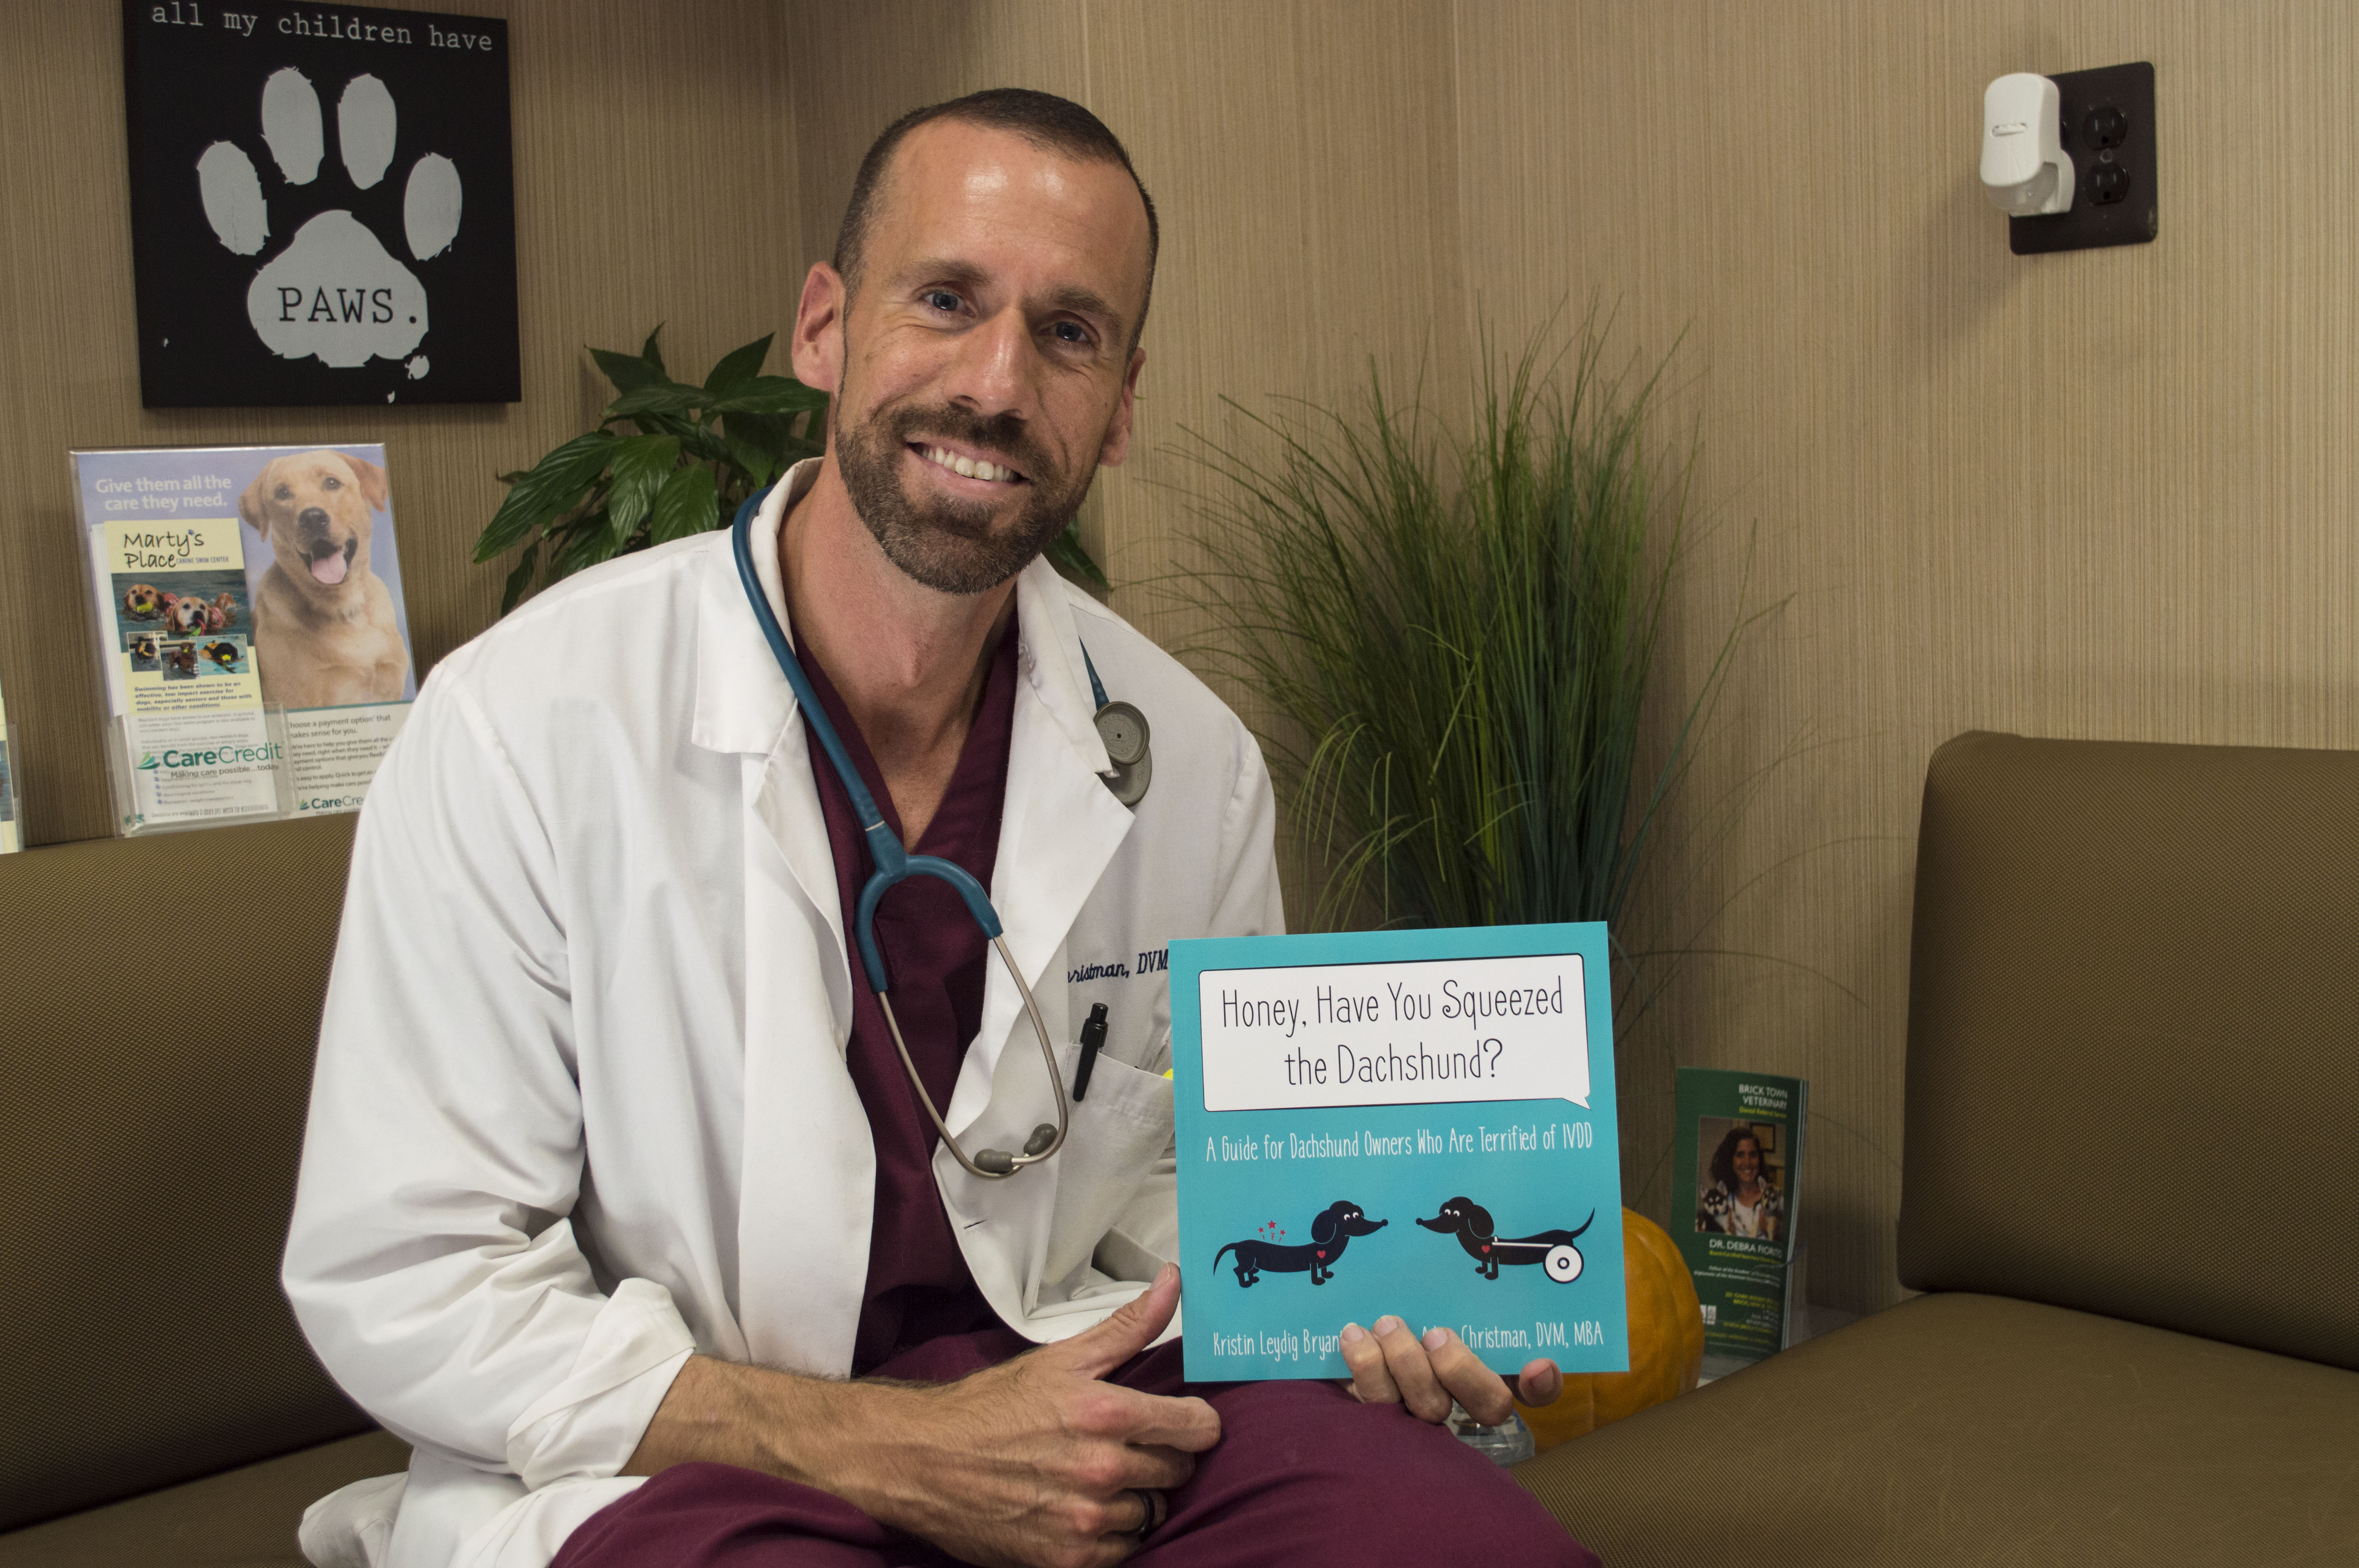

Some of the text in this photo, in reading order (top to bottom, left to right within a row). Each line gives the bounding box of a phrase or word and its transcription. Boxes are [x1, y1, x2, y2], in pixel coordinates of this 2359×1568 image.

[152, 2, 493, 51] all my children have
[277, 286, 418, 325] PAWS.
[96, 474, 232, 494] Give them all the
[105, 492, 228, 513] care they need.
[124, 529, 205, 557] Marty's
[124, 550, 176, 569] Place
[318, 718, 349, 728] payment
[163, 742, 284, 768] CareCredit
[311, 795, 363, 809] CareCre
[1136, 949, 1169, 975] DVM
[1221, 975, 1563, 1038] Honey, Have You Squeezed
[1284, 1038, 1503, 1085] the Dachshund?
[1206, 1122, 1592, 1162] A Guide for Dachshund Owners Who Are Terrified of IVDD
[1214, 1332, 1255, 1356] Kristin
[1260, 1329, 1299, 1362] Leydig
[1461, 1324, 1532, 1350] Christman,
[1536, 1321, 1569, 1348] DVM,
[1574, 1320, 1604, 1346] MBA
